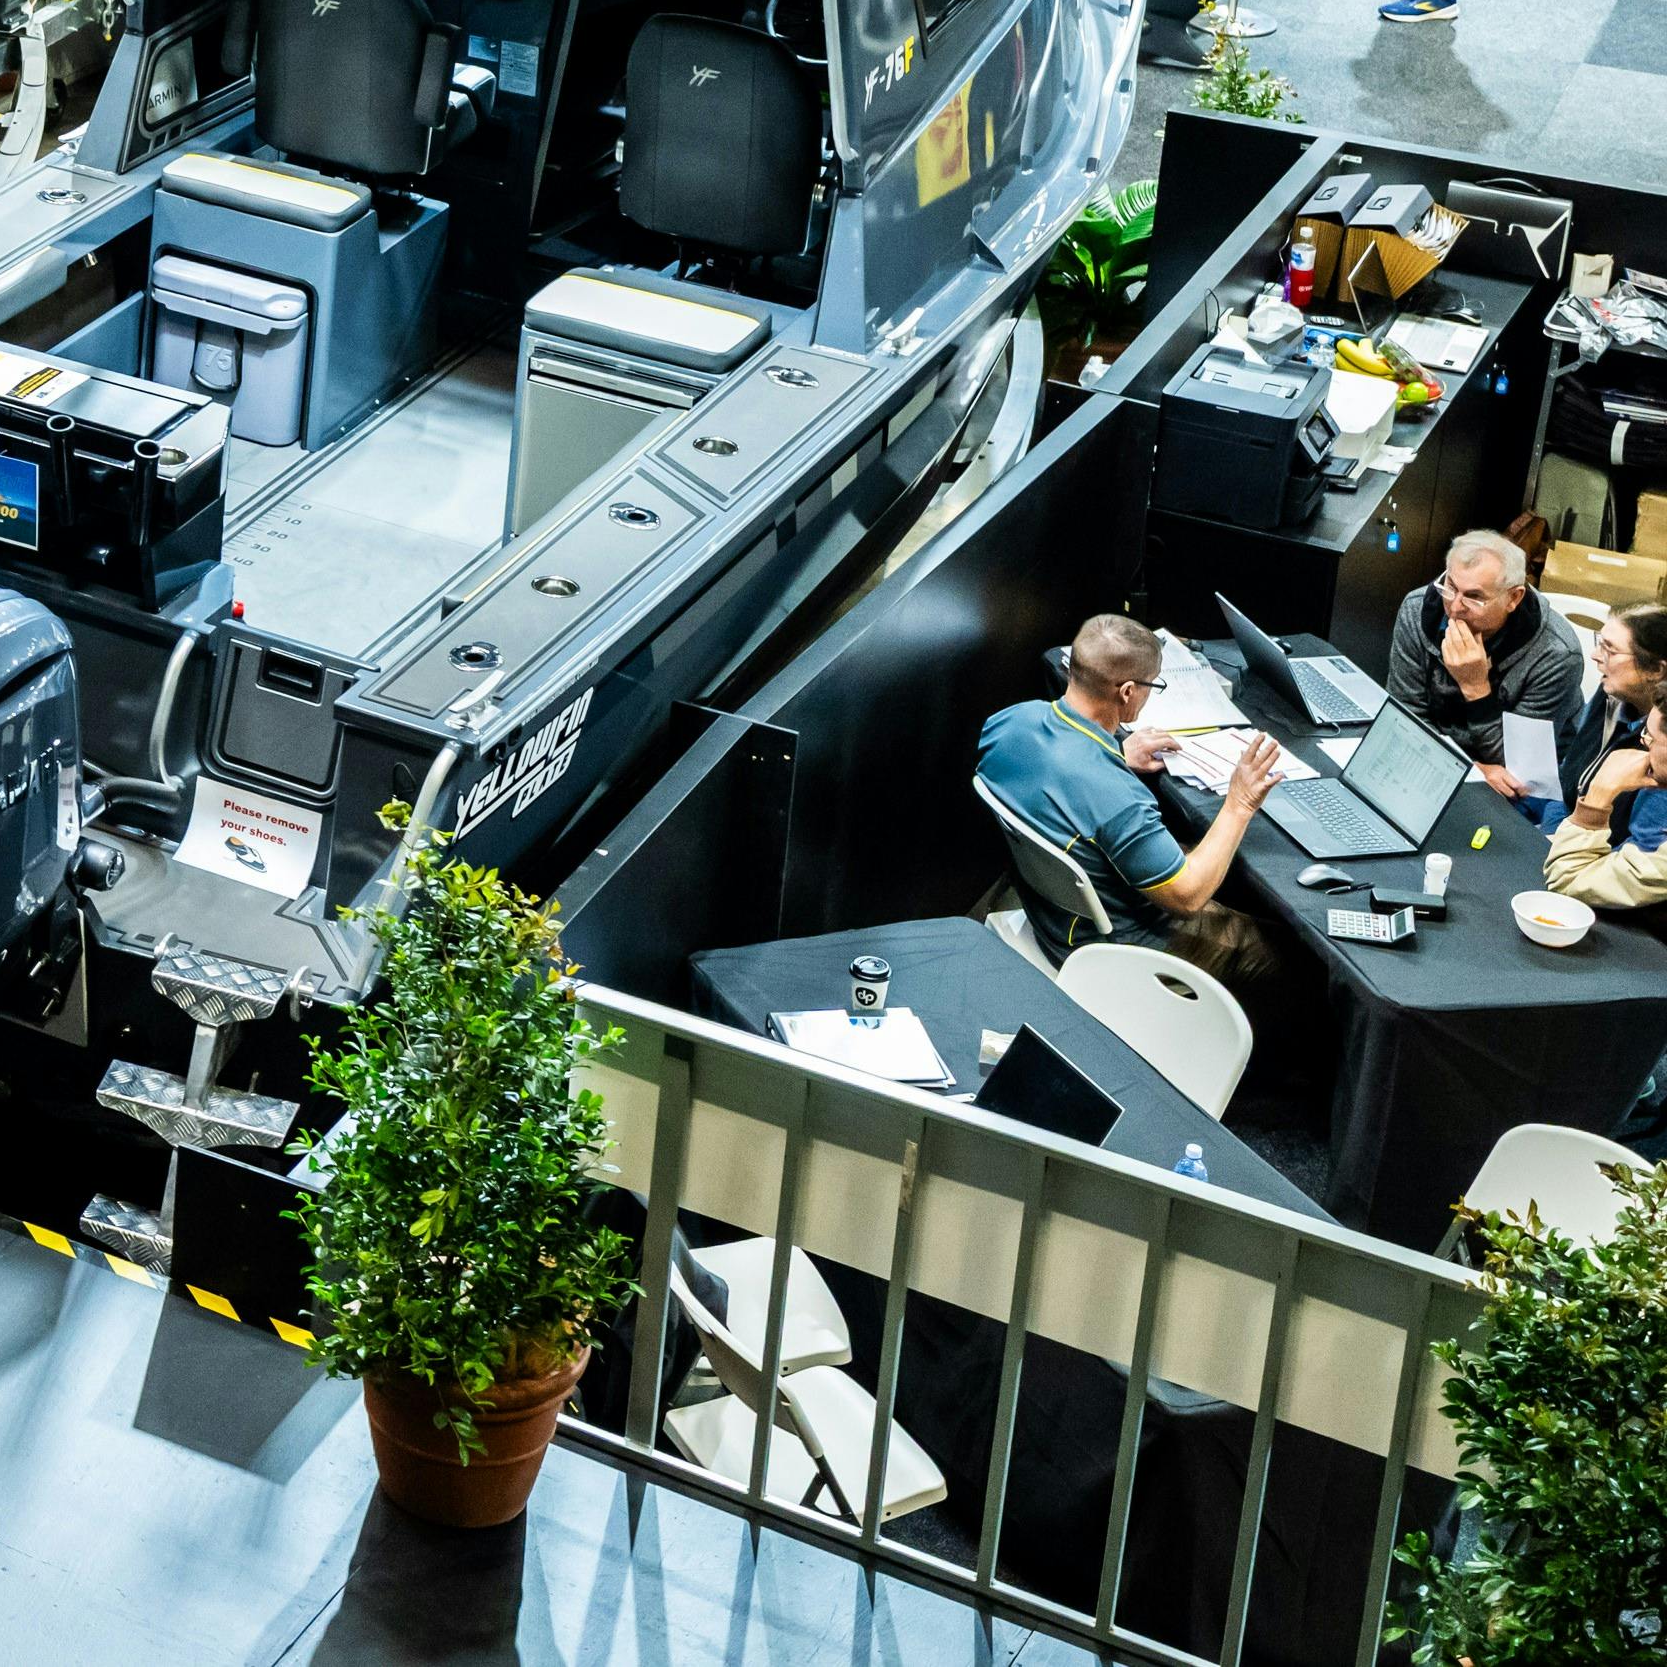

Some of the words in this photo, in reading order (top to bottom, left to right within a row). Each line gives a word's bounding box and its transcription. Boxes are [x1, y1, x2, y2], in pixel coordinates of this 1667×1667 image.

[147, 87, 182, 110] ARMIN
[284, 517, 302, 526] 10
[454, 686, 594, 834] YELLOWFIN
[223, 799, 264, 821] Please
[265, 813, 309, 835] remove
[220, 818, 247, 835] your
[249, 826, 288, 846] shoes.
